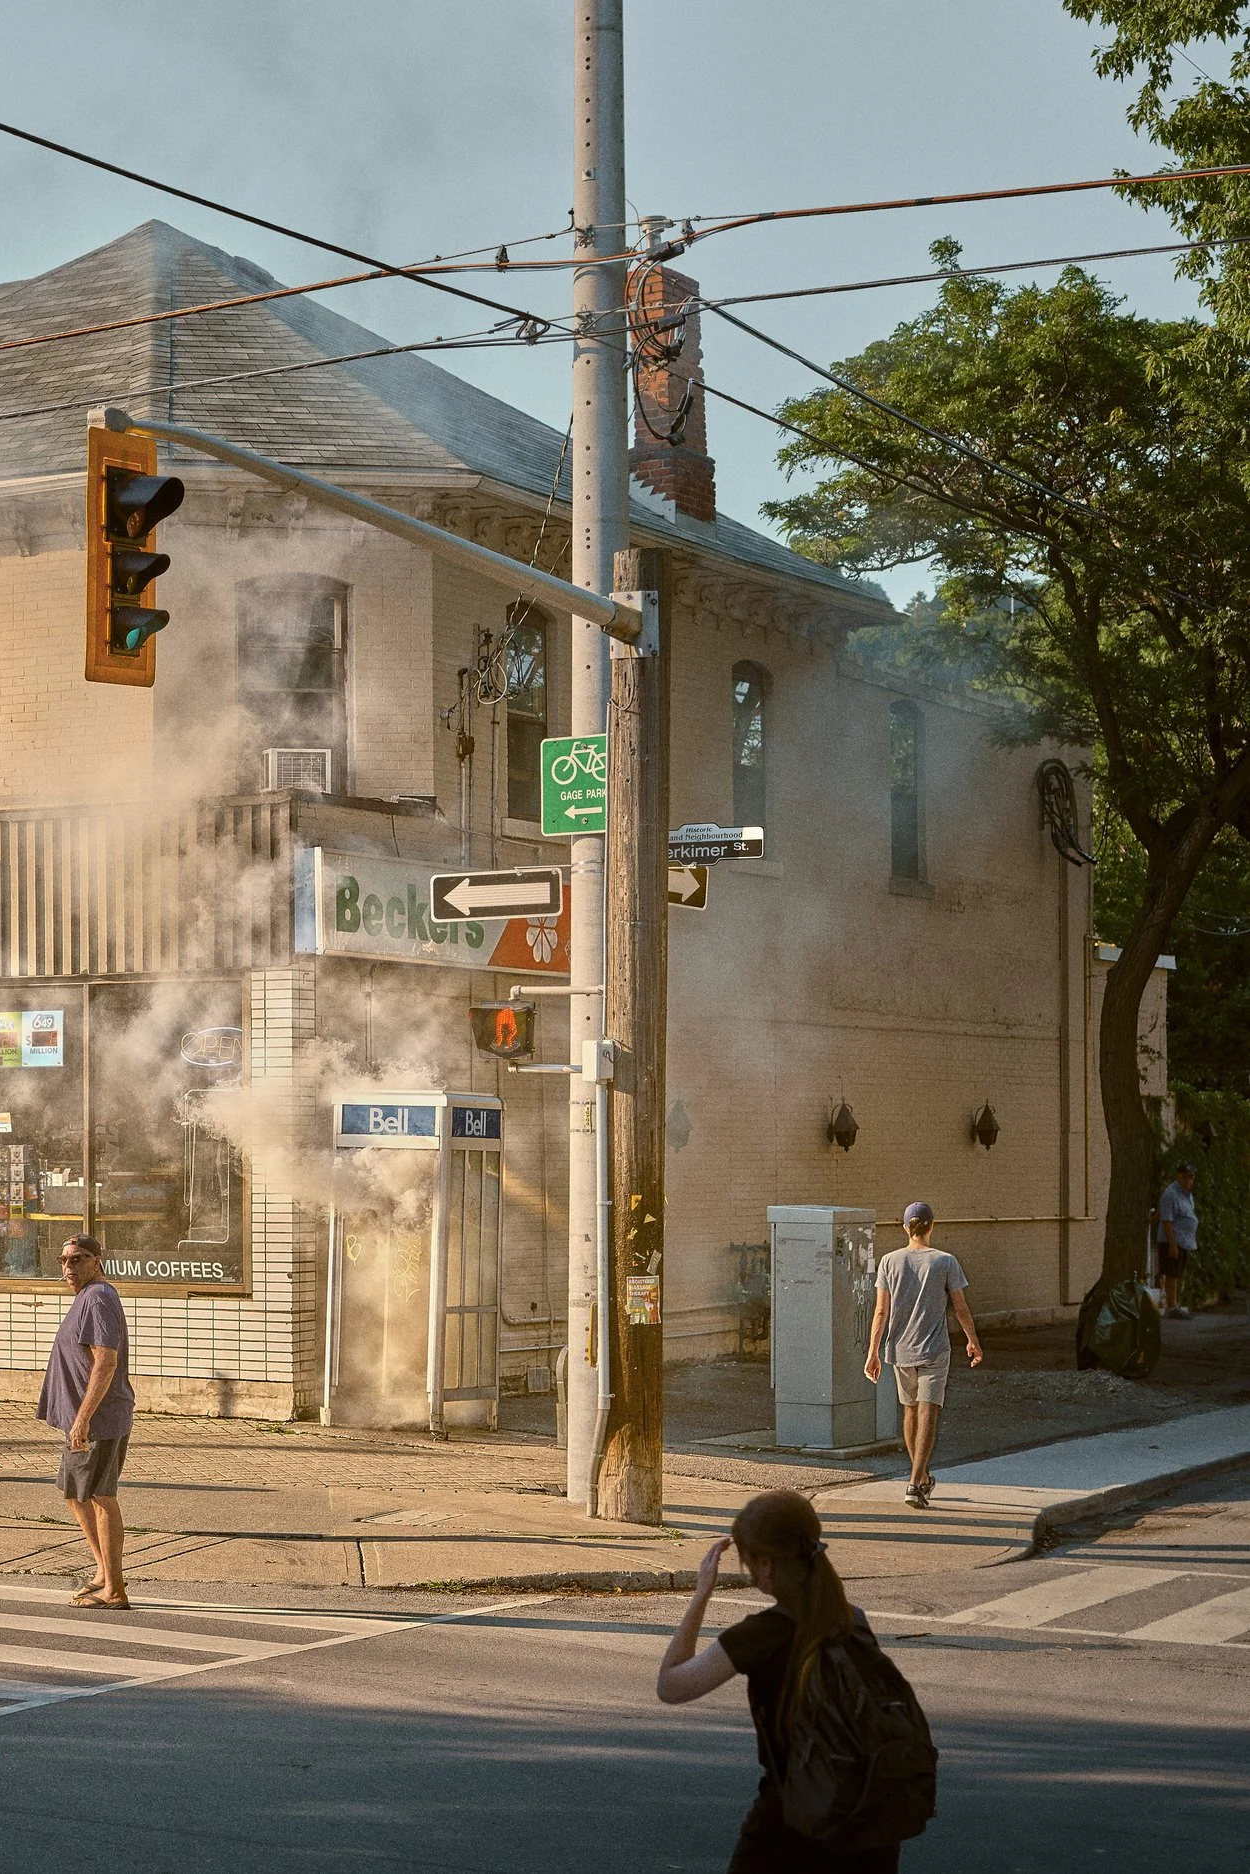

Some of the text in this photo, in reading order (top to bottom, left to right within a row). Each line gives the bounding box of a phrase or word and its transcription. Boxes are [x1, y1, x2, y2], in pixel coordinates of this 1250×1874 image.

[560, 788, 607, 801] GAGE PARK
[668, 831, 743, 842] and Neighbourhood
[668, 841, 750, 859] erkimer St.
[29, 1047, 58, 1055] MILLION
[369, 1107, 409, 1134] Bell
[465, 1110, 487, 1136] Bell
[99, 1259, 225, 1279] MIUM COFFEES
